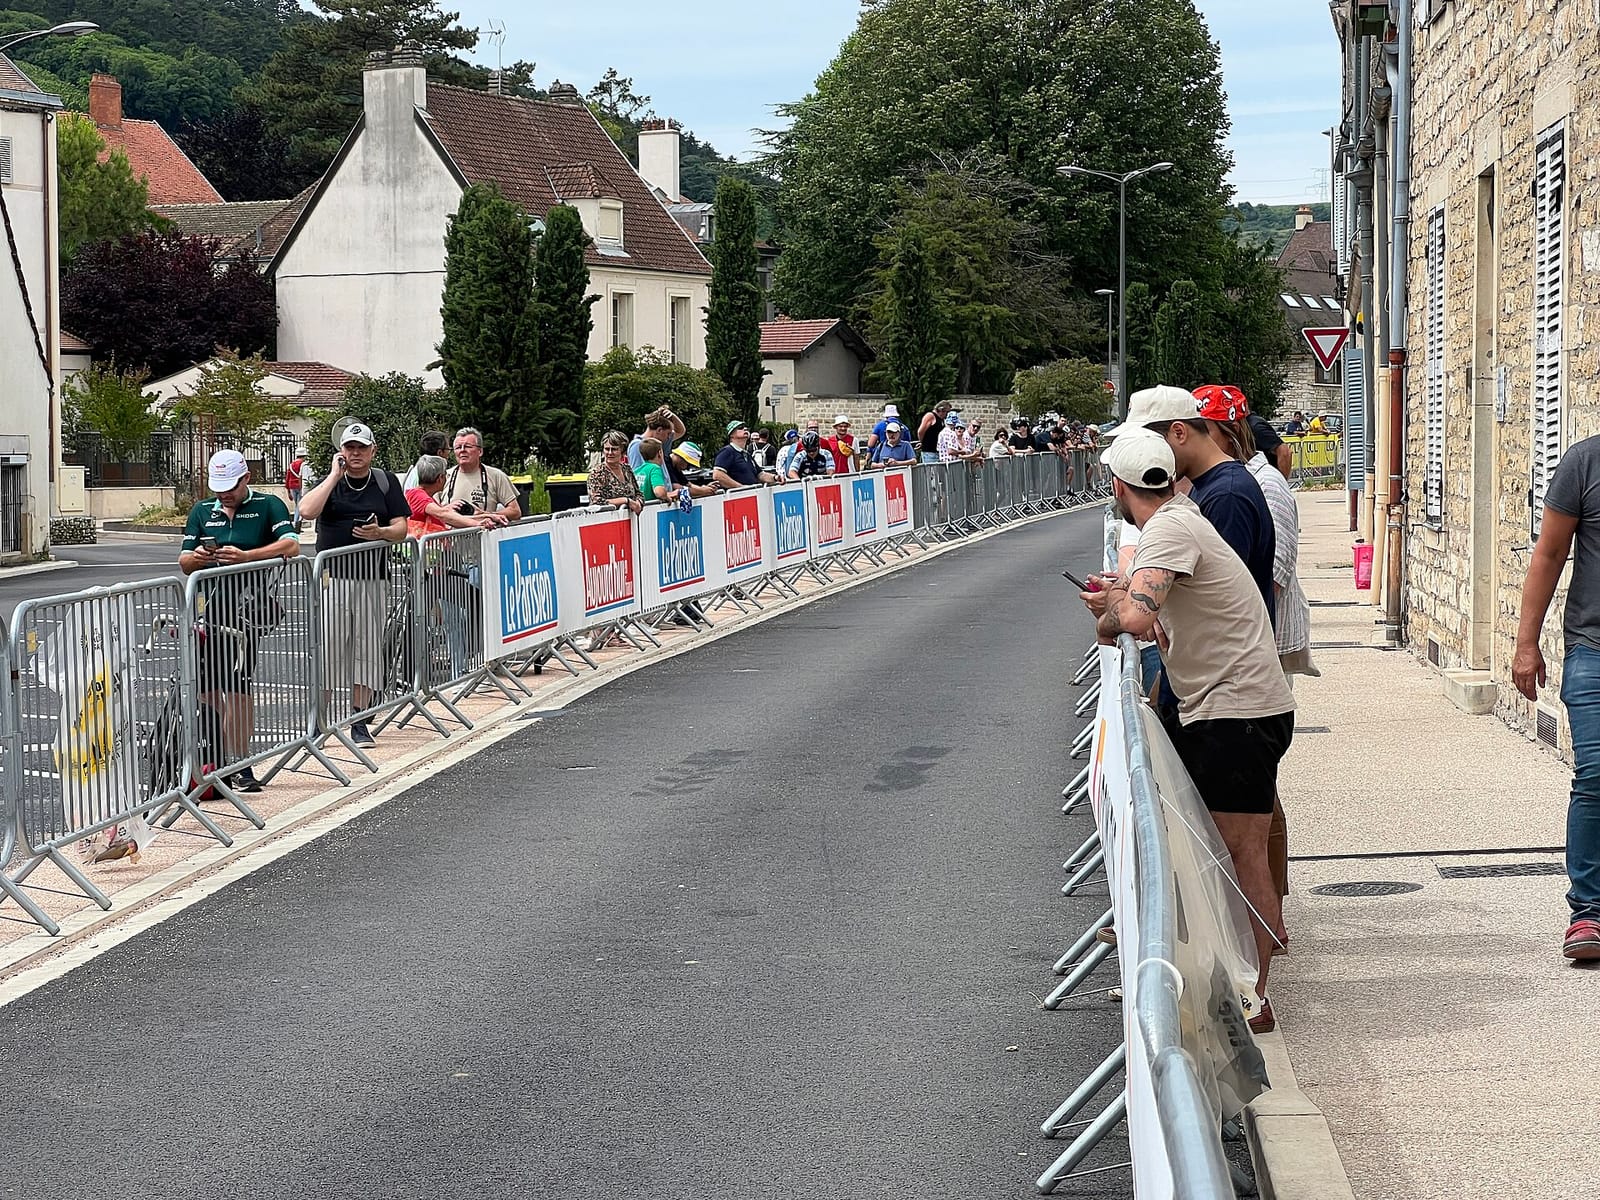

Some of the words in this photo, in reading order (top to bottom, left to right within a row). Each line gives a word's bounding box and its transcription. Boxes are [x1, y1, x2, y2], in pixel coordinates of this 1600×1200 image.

[661, 537, 672, 584] Le
[669, 521, 701, 582] Parisien
[781, 501, 804, 552] Parisien
[504, 574, 516, 633] Le
[513, 552, 553, 630] Parisien
[584, 543, 626, 608] Aujourd'hui
